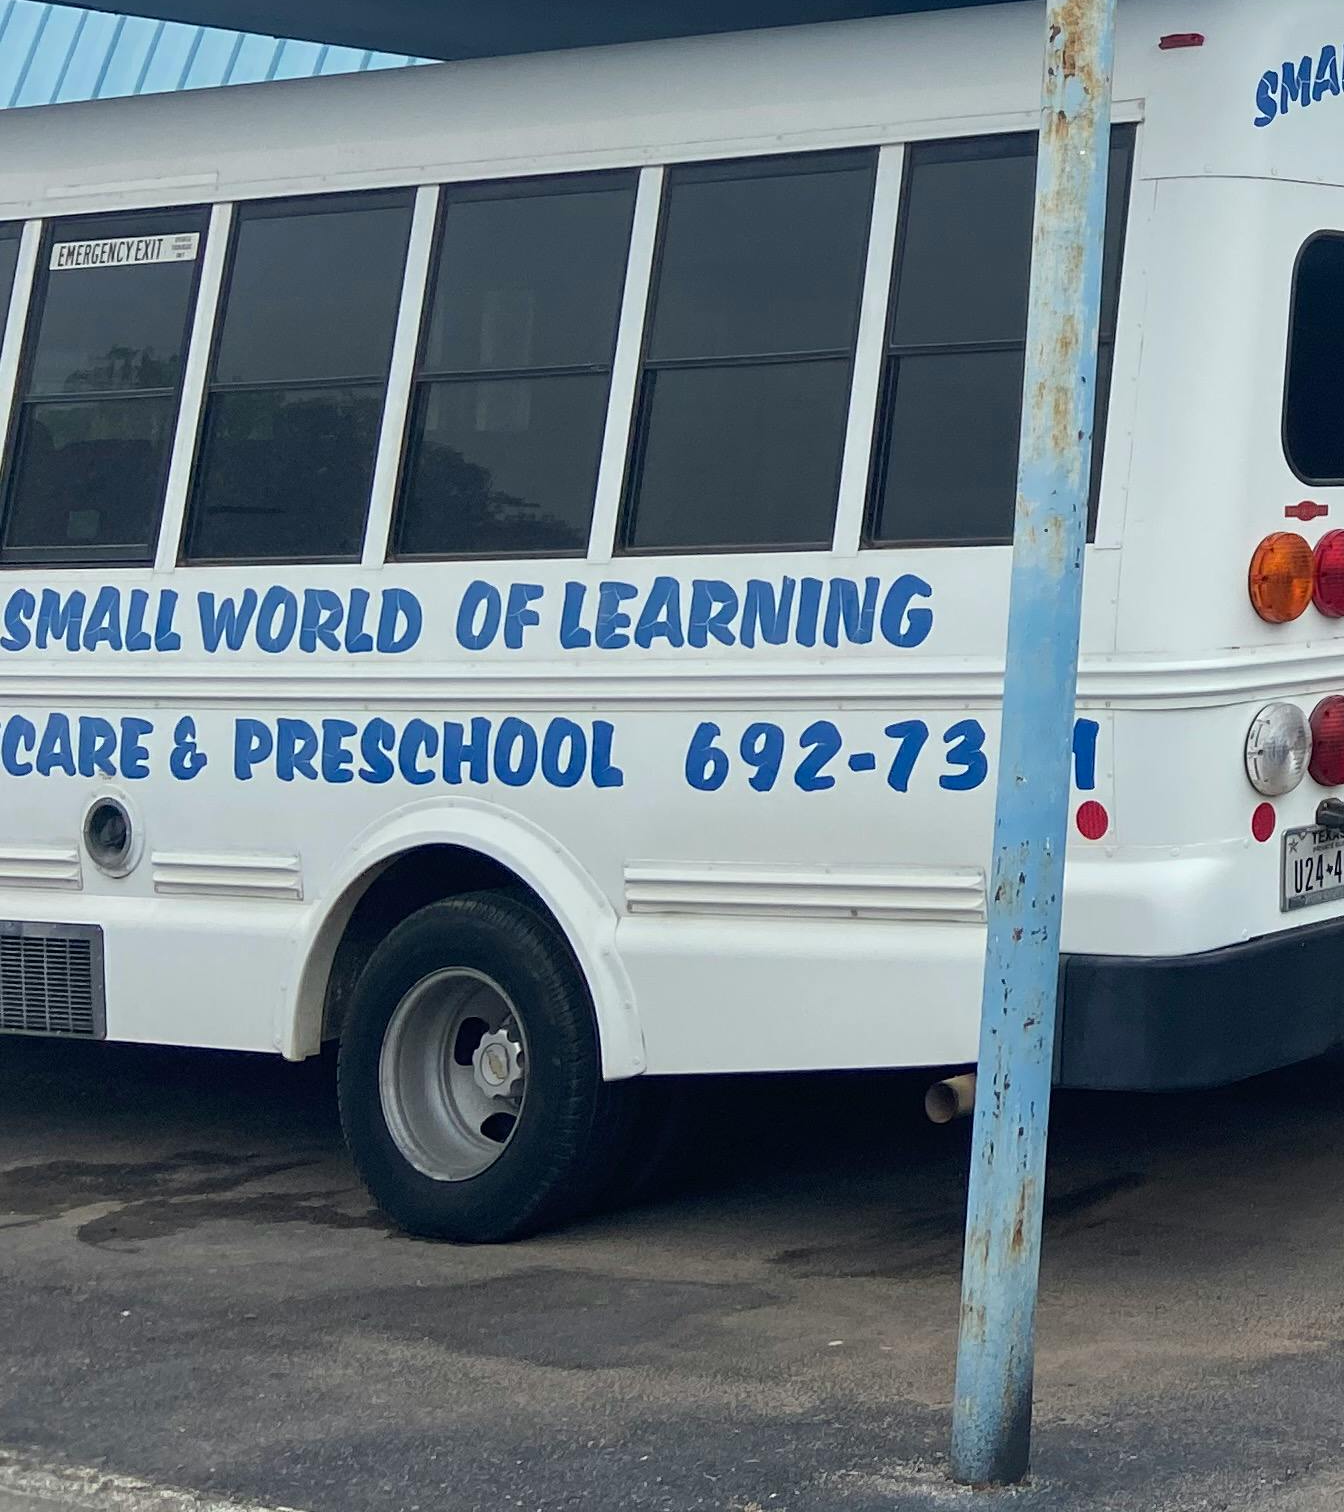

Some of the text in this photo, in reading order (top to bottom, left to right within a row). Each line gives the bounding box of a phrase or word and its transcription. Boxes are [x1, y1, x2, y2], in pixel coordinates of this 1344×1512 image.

[57, 241, 134, 267] EMERGENCY
[134, 238, 164, 262] EXIT
[0, 574, 934, 655] SMALL WORLD OF LEARNING
[0, 711, 1099, 793] CARE & PRESCHOOL 692-731
